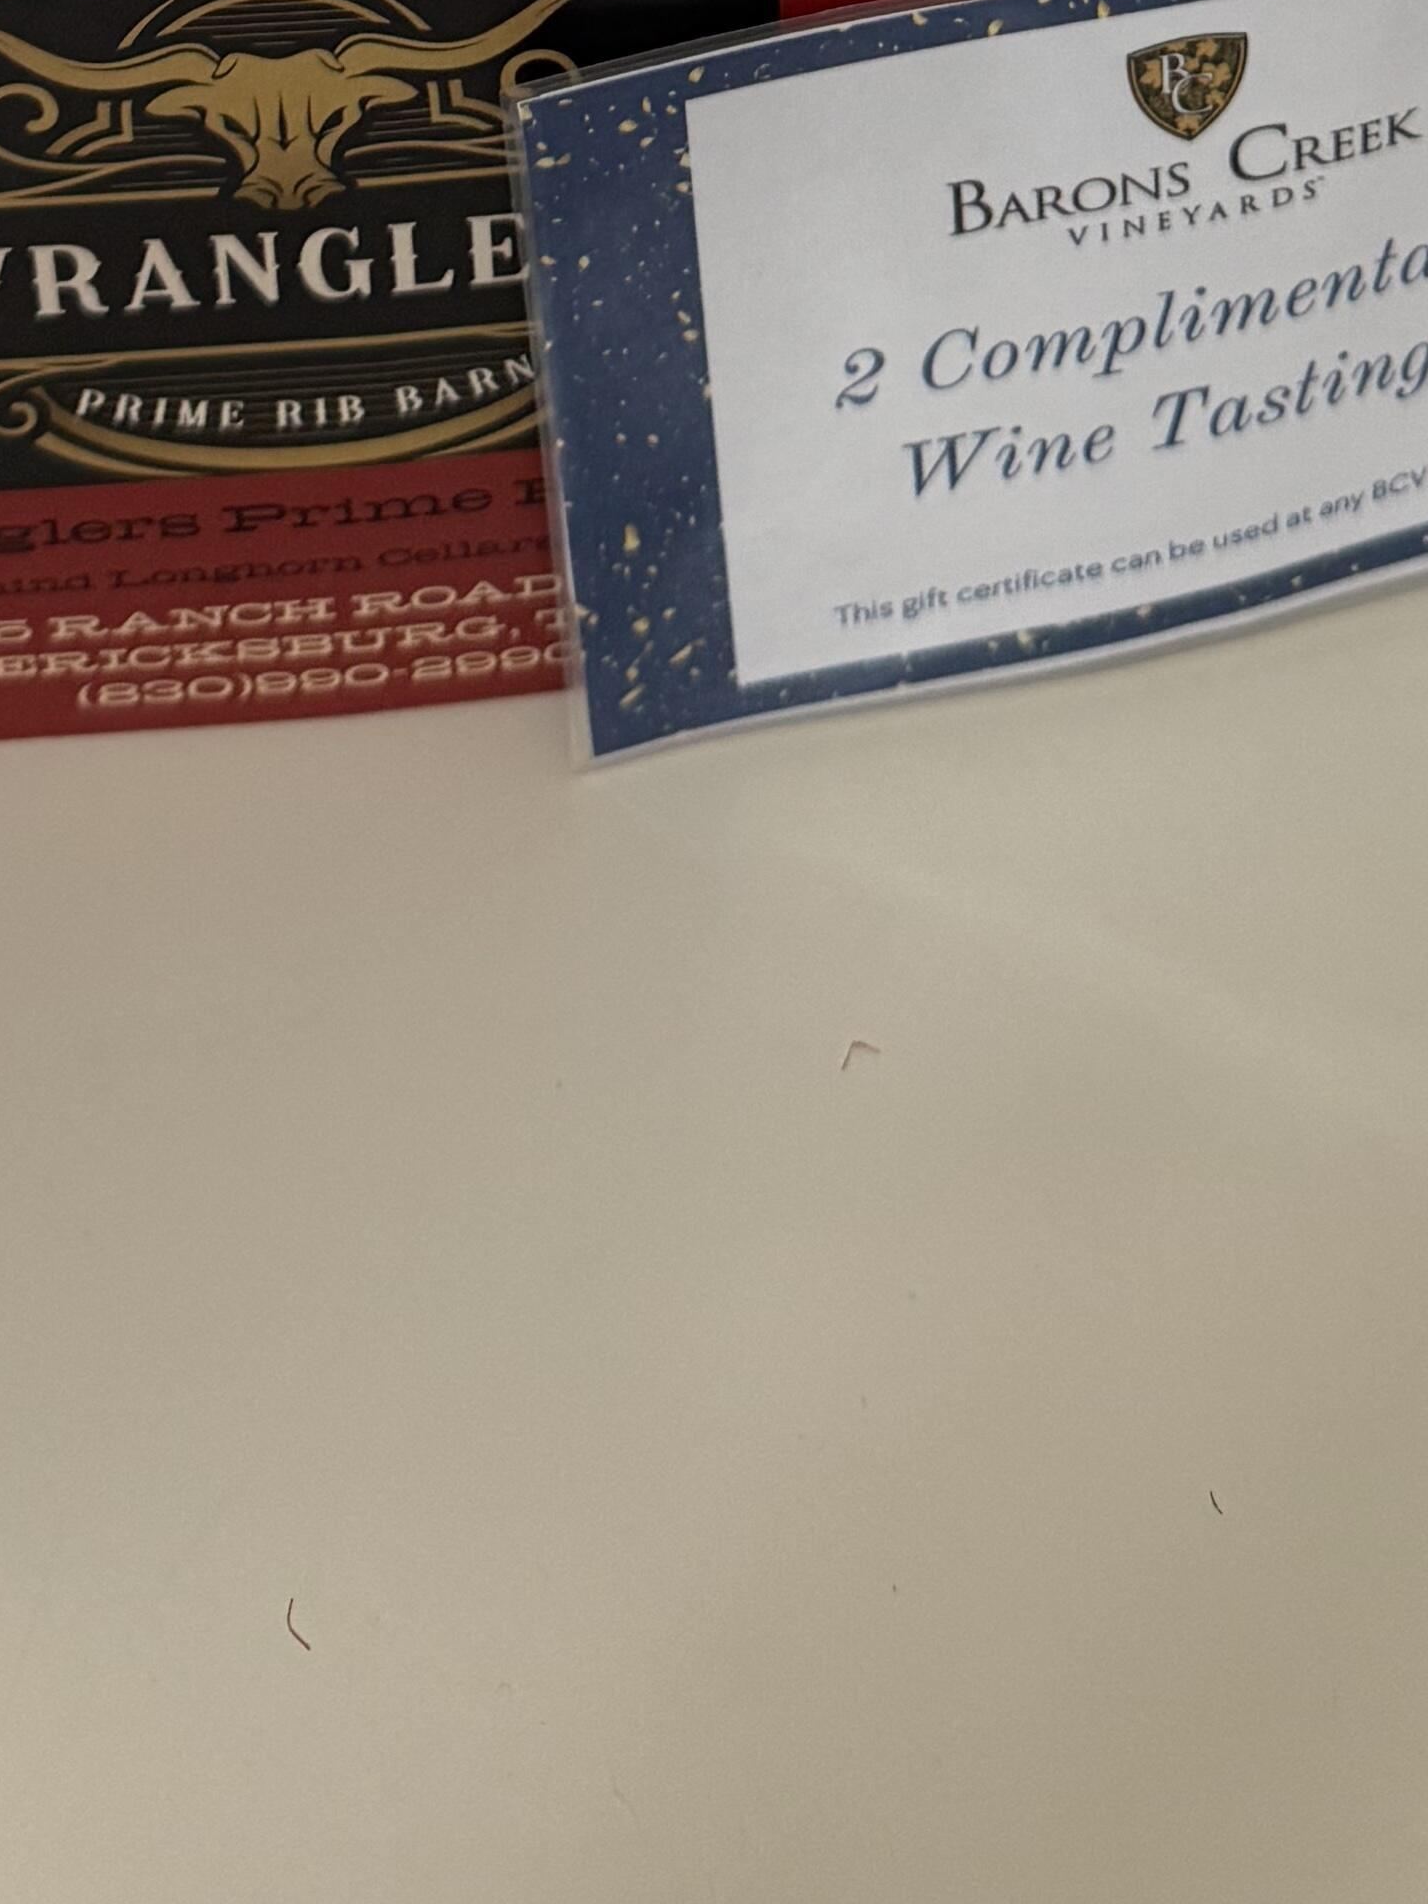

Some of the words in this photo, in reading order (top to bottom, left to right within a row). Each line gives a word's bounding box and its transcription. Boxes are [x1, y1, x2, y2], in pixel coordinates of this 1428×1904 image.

[946, 159, 1192, 239] BARONS
[1229, 107, 1424, 185] CREEK
[1067, 178, 1320, 247] VINEYARDS
[73, 386, 247, 431] PRIME
[276, 394, 368, 429] RIB
[395, 352, 537, 420] BARN
[835, 346, 886, 410] 2
[901, 421, 1115, 499] Wine
[223, 487, 493, 535] Prime
[108, 550, 365, 593] Longhorn
[834, 594, 895, 630] This
[900, 583, 948, 620] gift
[955, 558, 1104, 607] certificate
[1111, 548, 1164, 576] can
[1169, 536, 1207, 562] be
[1211, 513, 1281, 552] used
[1286, 506, 1313, 531] at
[1317, 491, 1366, 525] any
[1371, 468, 1428, 504] BCV
[47, 596, 336, 642] RANCH
[352, 571, 564, 614] ROAD
